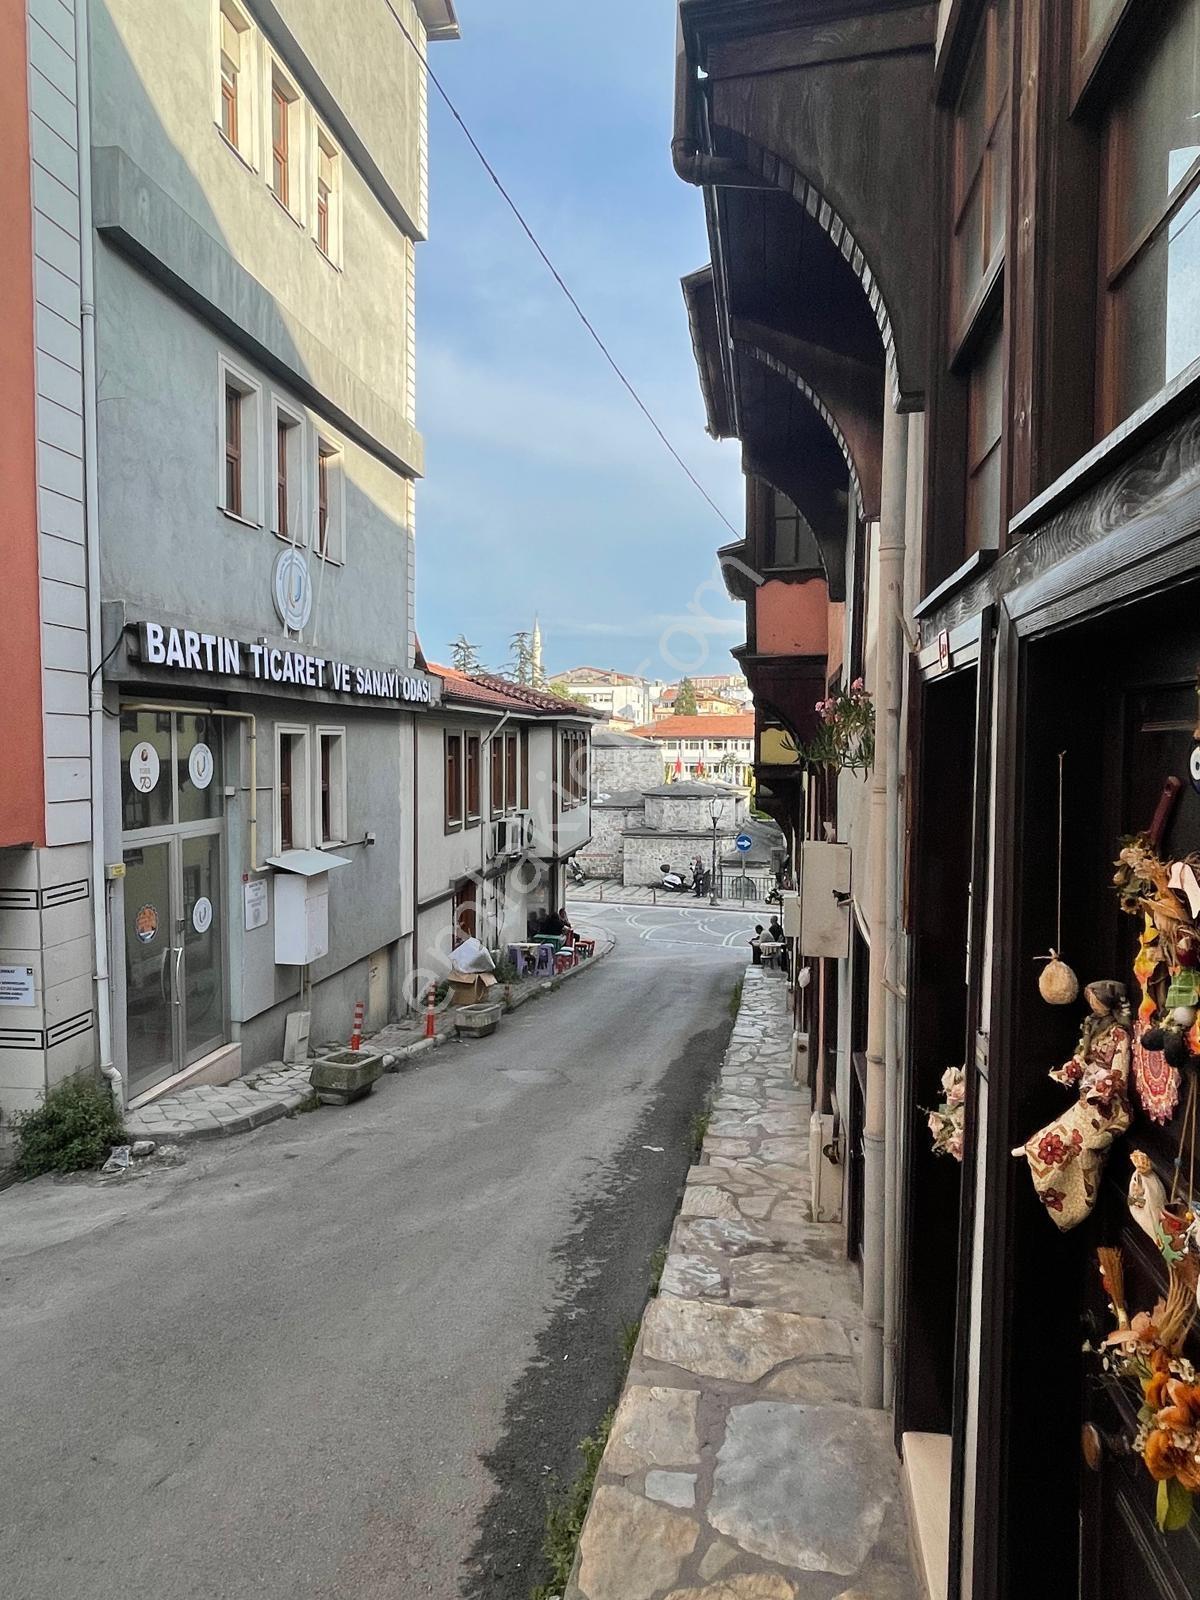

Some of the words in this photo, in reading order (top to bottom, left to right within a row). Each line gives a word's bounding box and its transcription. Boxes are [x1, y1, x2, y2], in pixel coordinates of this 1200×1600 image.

[146, 622, 240, 675] BARTIN
[250, 638, 325, 687] TİCARET
[331, 661, 351, 691] VE
[356, 667, 400, 699] SANAYİ
[402, 676, 432, 703] ODASI
